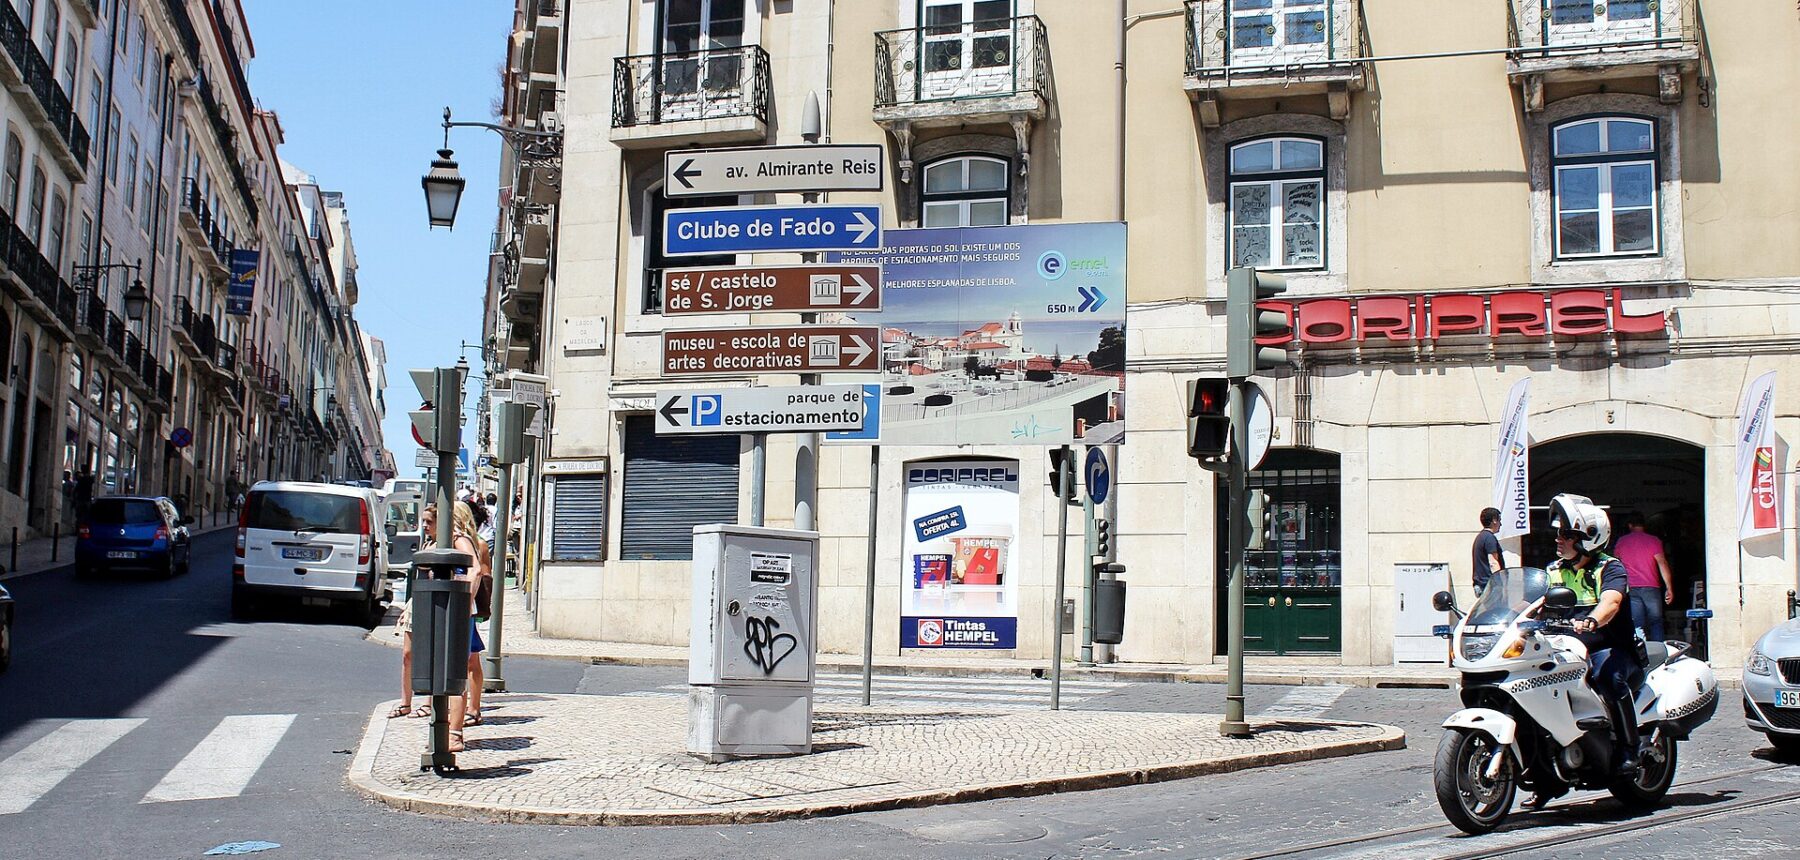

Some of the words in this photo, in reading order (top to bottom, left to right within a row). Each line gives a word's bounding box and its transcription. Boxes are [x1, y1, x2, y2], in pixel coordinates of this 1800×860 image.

[726, 166, 748, 179] av.
[757, 159, 833, 177] Almirante
[843, 158, 876, 174] Reis
[677, 220, 740, 240] Clube
[746, 219, 774, 238] de
[780, 217, 836, 237] Fado
[882, 246, 897, 254] DAS
[899, 245, 929, 254] PORTAS
[931, 245, 942, 253] DO
[944, 244, 959, 252] SOL
[962, 243, 987, 252] EXISTE
[988, 243, 1002, 251] UM
[1004, 242, 1021, 251] DOS
[879, 256, 889, 265] DE
[891, 254, 959, 264] ESTACIONAMENTO
[961, 254, 981, 262] MAIS
[982, 252, 1021, 262] SEGUROS
[670, 274, 691, 291] sé
[696, 272, 705, 292] /
[710, 273, 777, 289] castelo
[885, 279, 925, 289] MELHORES
[927, 278, 975, 288] ESPLANADAS
[976, 278, 986, 286] DE
[669, 295, 691, 310] de
[700, 293, 718, 309] S.
[725, 292, 774, 311] Jorge
[1047, 304, 1067, 314] 650
[1068, 305, 1075, 313] M
[669, 336, 715, 351] museu
[731, 332, 781, 349] escola
[787, 332, 807, 348] de
[668, 354, 706, 371] artes
[713, 351, 802, 369] decorativas
[787, 392, 836, 405] parque
[843, 390, 860, 402] de
[695, 396, 718, 426] P
[724, 407, 860, 426] estacionamento
[909, 467, 1018, 483] CORIPREL
[1513, 459, 1527, 530] Robbialac
[922, 522, 951, 536] OFERTA
[963, 539, 999, 548] HEMPEL
[944, 619, 986, 631] Tintas
[944, 630, 999, 642] HEMPEL
